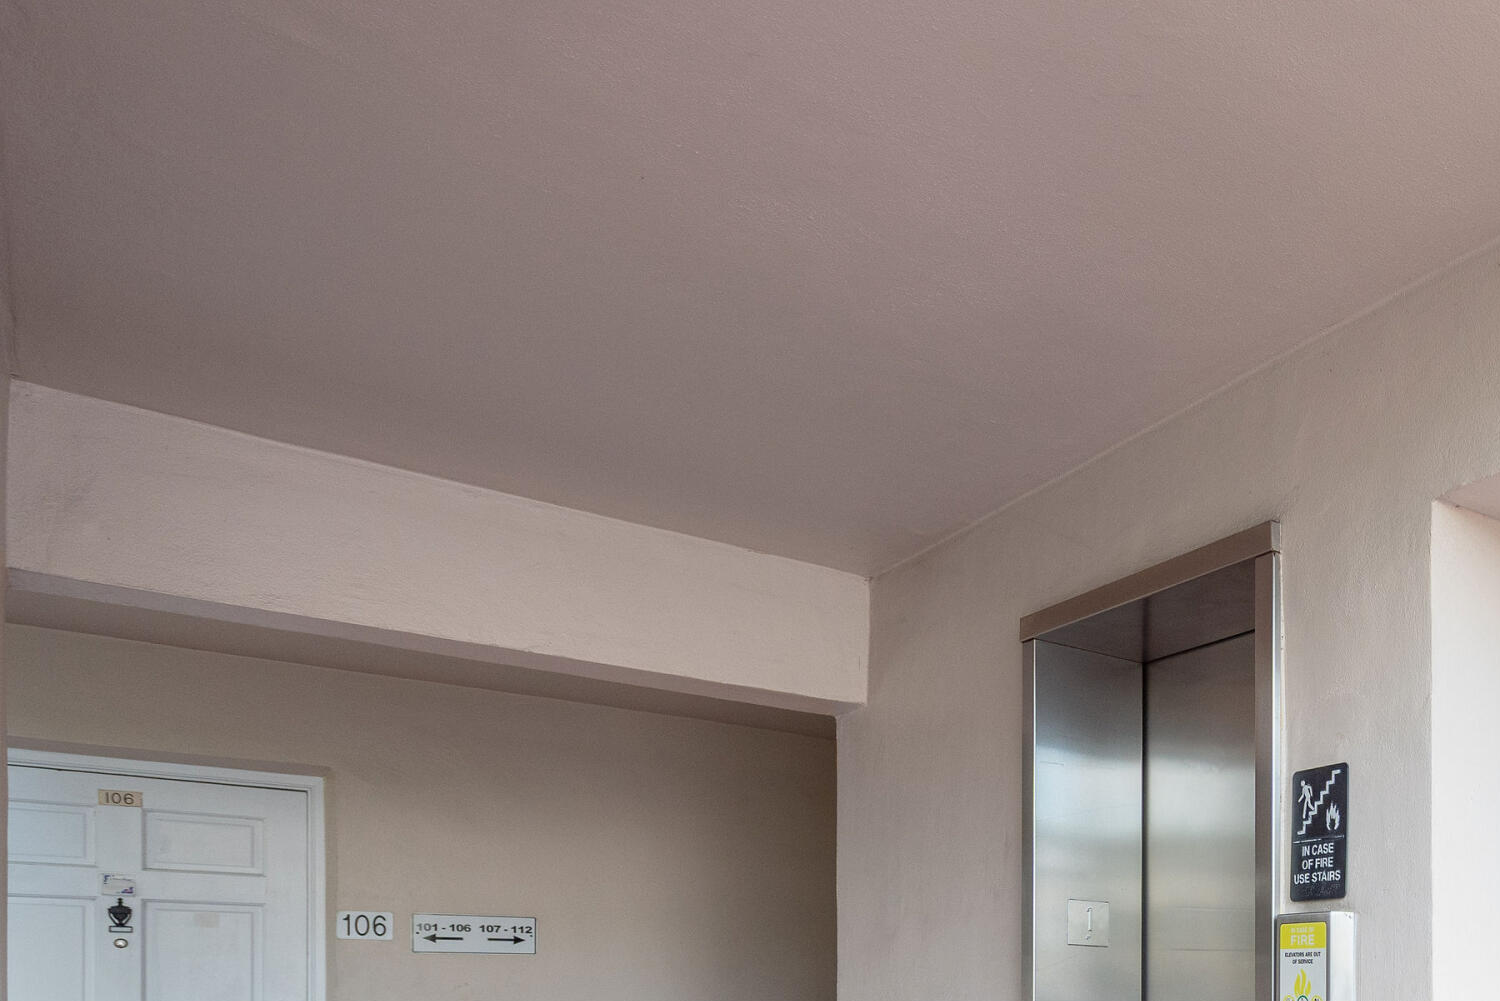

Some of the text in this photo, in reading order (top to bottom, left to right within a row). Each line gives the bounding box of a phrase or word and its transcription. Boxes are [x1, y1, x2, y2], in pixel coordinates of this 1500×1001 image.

[105, 791, 135, 805] 106
[1302, 842, 1334, 857] IN CASE
[1301, 857, 1334, 870] OF FIRE
[1293, 870, 1341, 884] USE STAIRS
[342, 914, 387, 936] 106
[416, 923, 438, 931] 101
[449, 923, 471, 932] 106
[479, 925, 501, 933] 107
[511, 926, 533, 934] 112
[1290, 934, 1315, 945] FIRE
